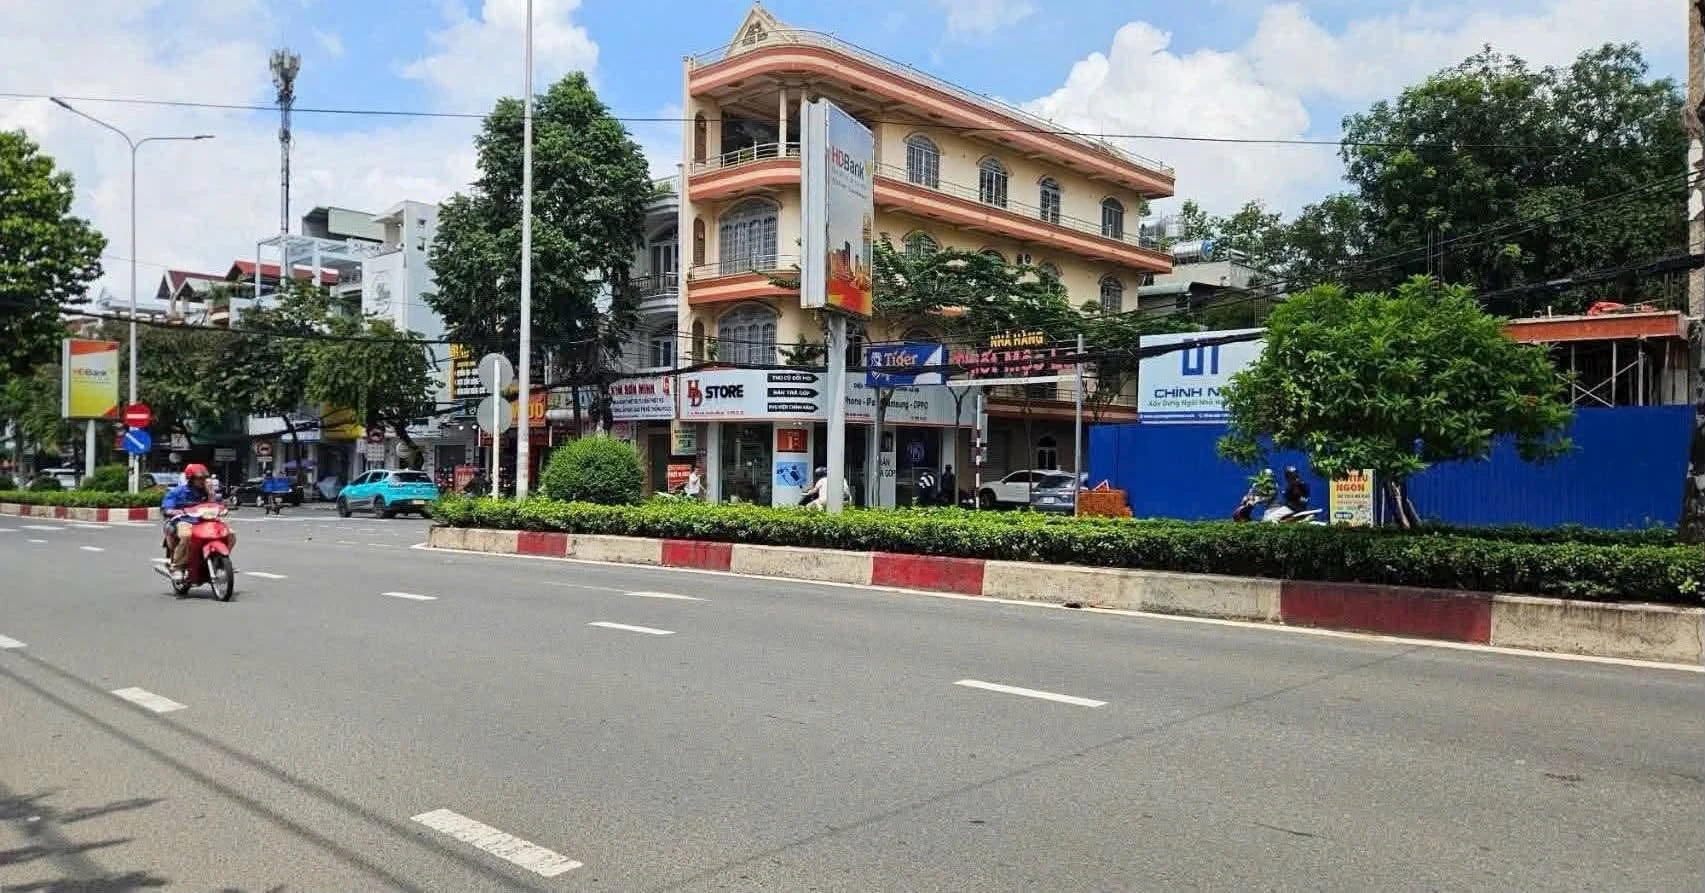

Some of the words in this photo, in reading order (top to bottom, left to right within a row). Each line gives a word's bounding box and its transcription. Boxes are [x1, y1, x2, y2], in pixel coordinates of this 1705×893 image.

[831, 144, 865, 180] HDBank
[705, 384, 744, 399] STORE
[1154, 387, 1202, 398] CHÍNH
